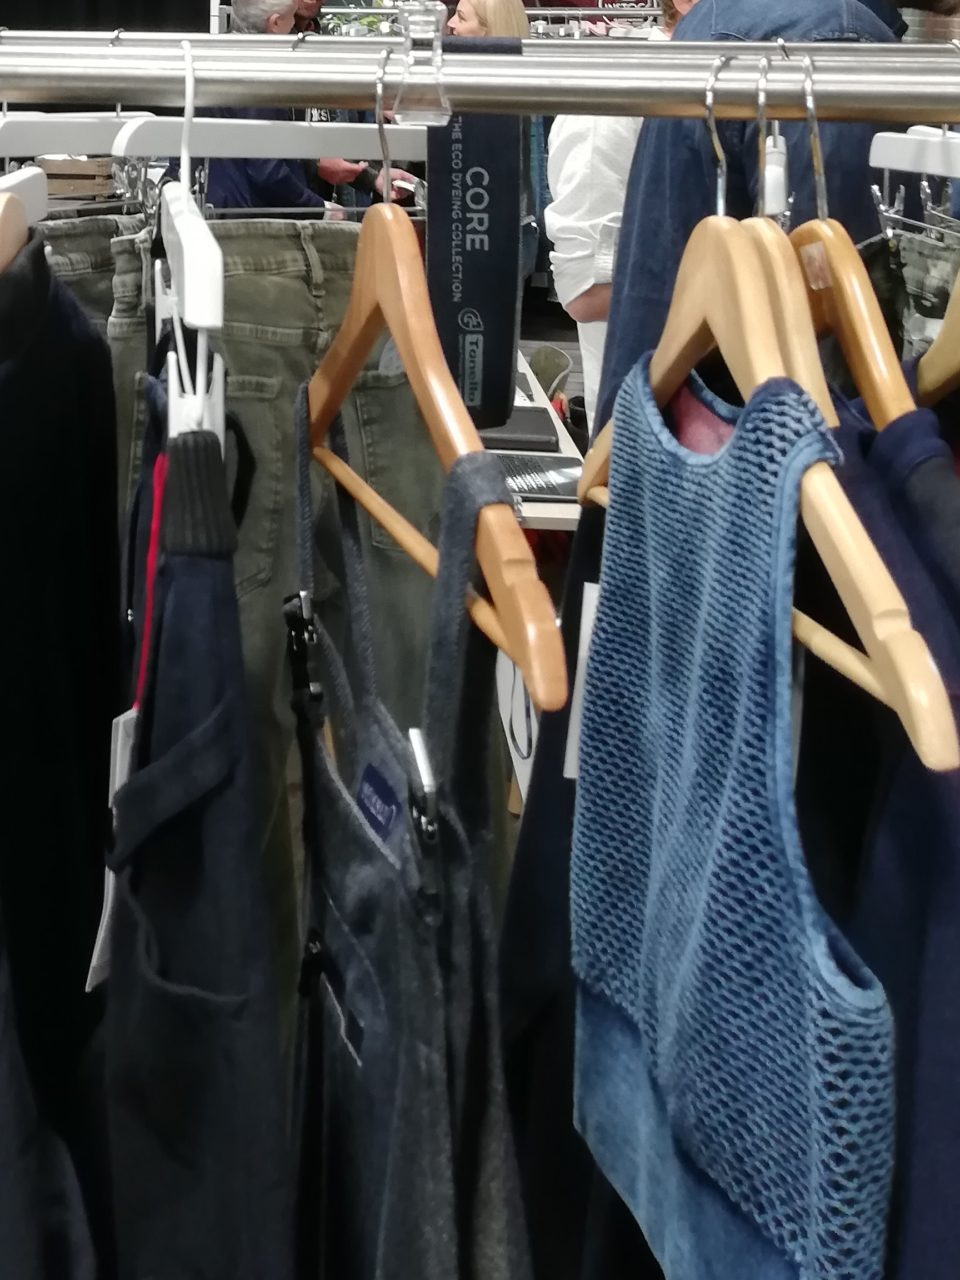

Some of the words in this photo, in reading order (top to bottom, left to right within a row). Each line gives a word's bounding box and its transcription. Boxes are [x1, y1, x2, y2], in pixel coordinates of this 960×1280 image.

[452, 143, 462, 169] ECO
[452, 173, 462, 219] DYEING
[465, 166, 490, 252] CORE
[452, 222, 462, 302] COLLECTION
